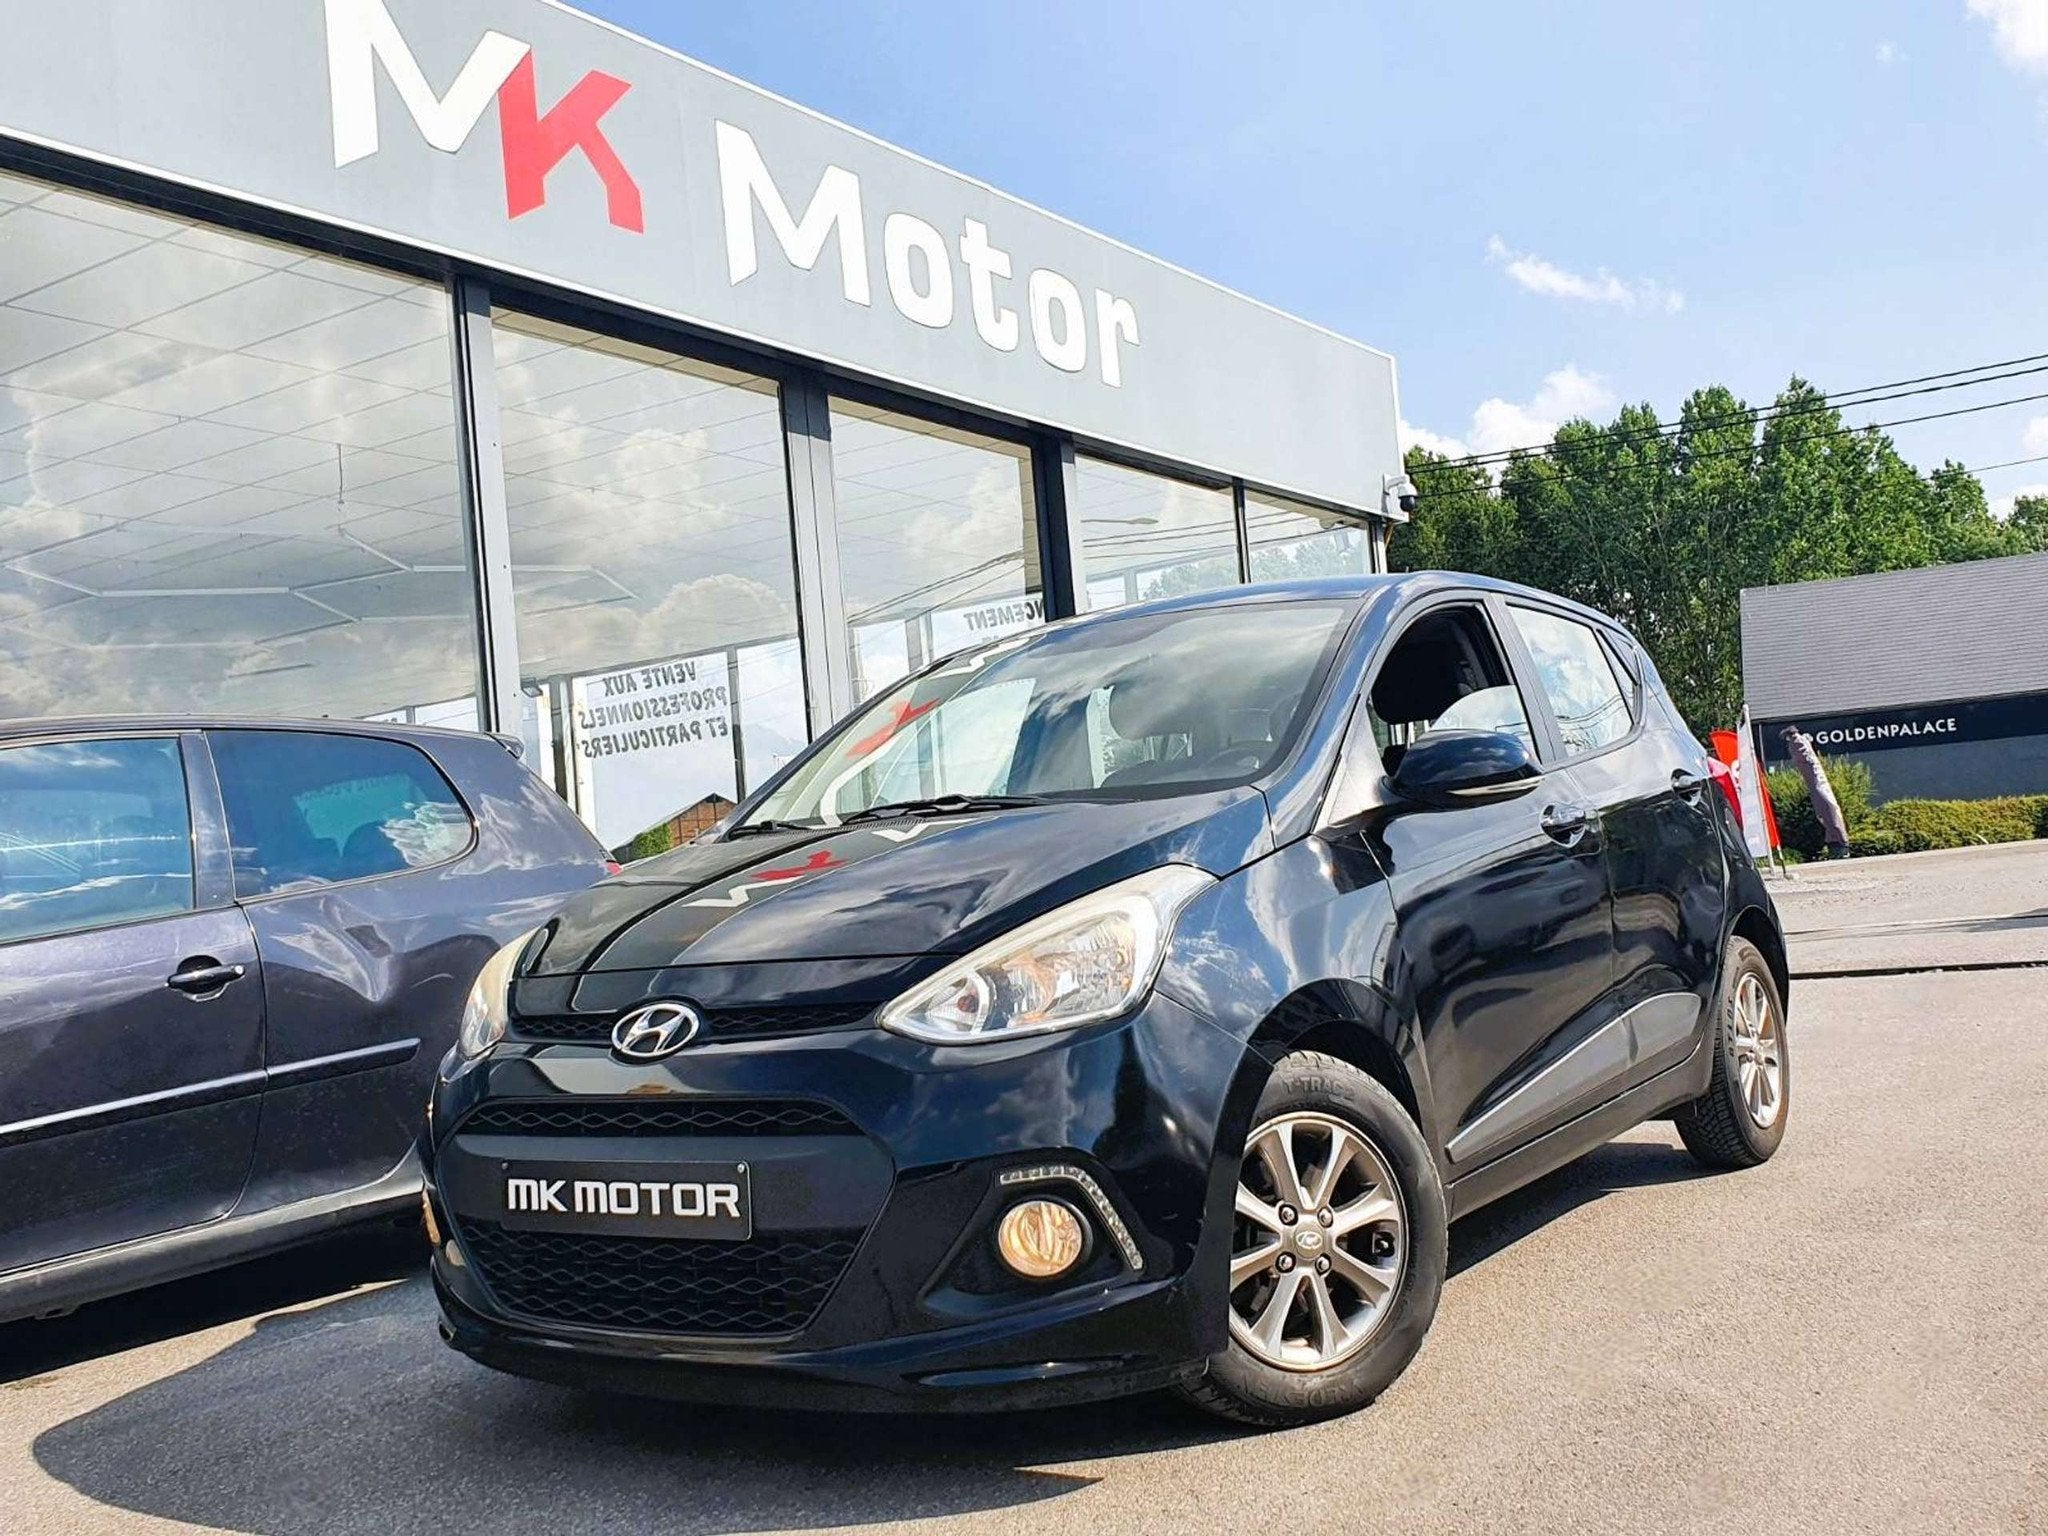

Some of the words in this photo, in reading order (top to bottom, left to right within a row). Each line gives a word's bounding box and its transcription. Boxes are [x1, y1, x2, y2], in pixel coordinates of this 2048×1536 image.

[324, 0, 644, 235] MK
[713, 117, 1141, 388] Motor
[1816, 718, 1957, 745] GOLDENPALACE
[508, 1178, 568, 1212] MK
[574, 1180, 741, 1218] MOTOR
